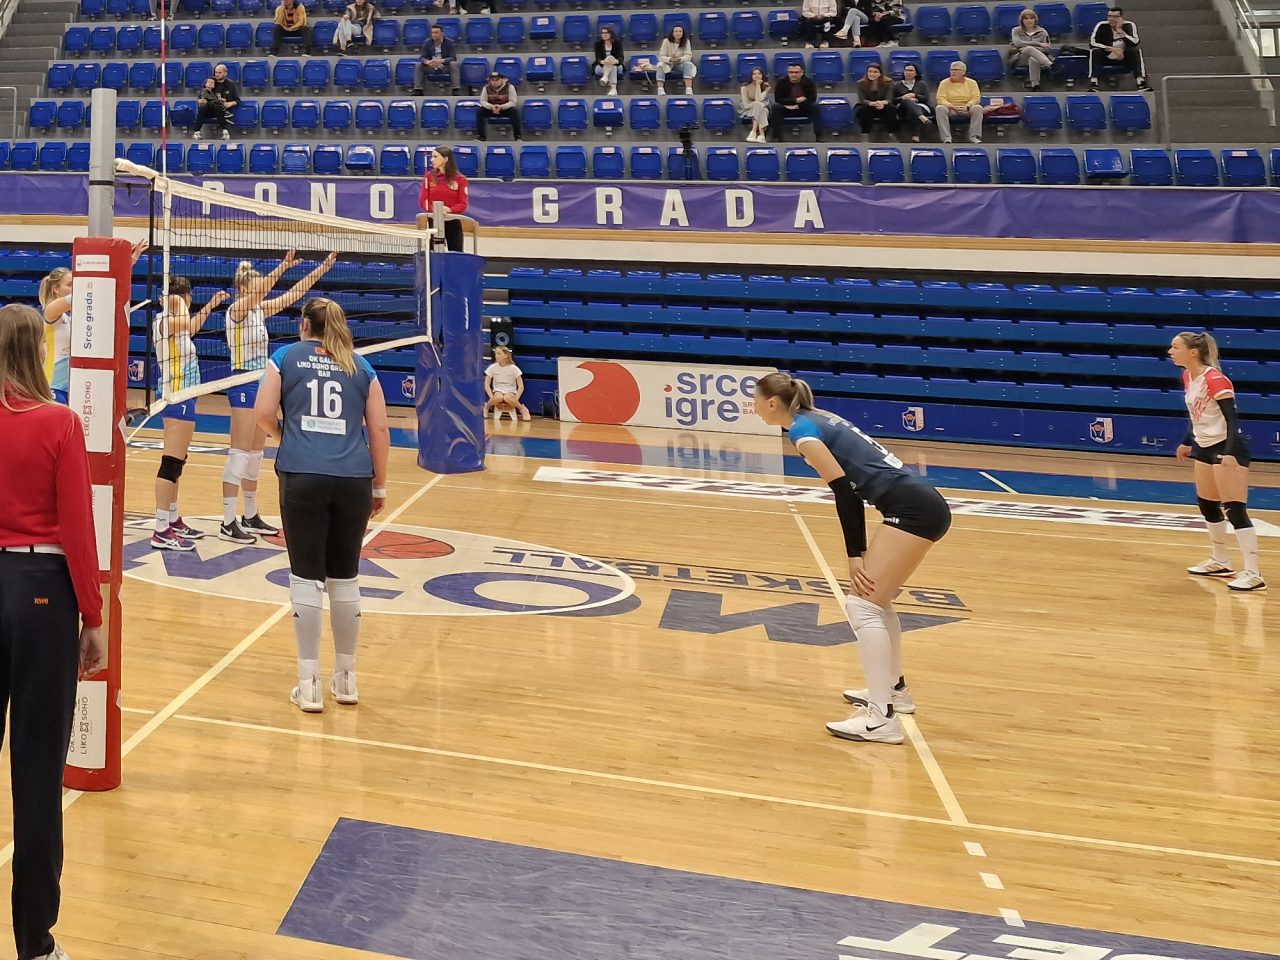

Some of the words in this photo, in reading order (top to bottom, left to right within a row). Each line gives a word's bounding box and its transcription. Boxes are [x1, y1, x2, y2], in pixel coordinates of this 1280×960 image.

[202, 181, 395, 220] PONO
[532, 187, 825, 229] GRADA
[84, 292, 94, 323] grada
[83, 325, 92, 349] Srce
[297, 361, 311, 369] LIKO
[317, 370, 331, 378] BAR
[84, 381, 92, 404] SOHO
[677, 372, 756, 397] srce
[240, 392, 246, 403] 6
[306, 378, 343, 419] 16
[664, 385, 740, 427] igre
[181, 404, 187, 416] 7
[493, 550, 968, 608] BSKETBALL
[81, 696, 89, 721] SOHO
[80, 734, 88, 755] LIKO
